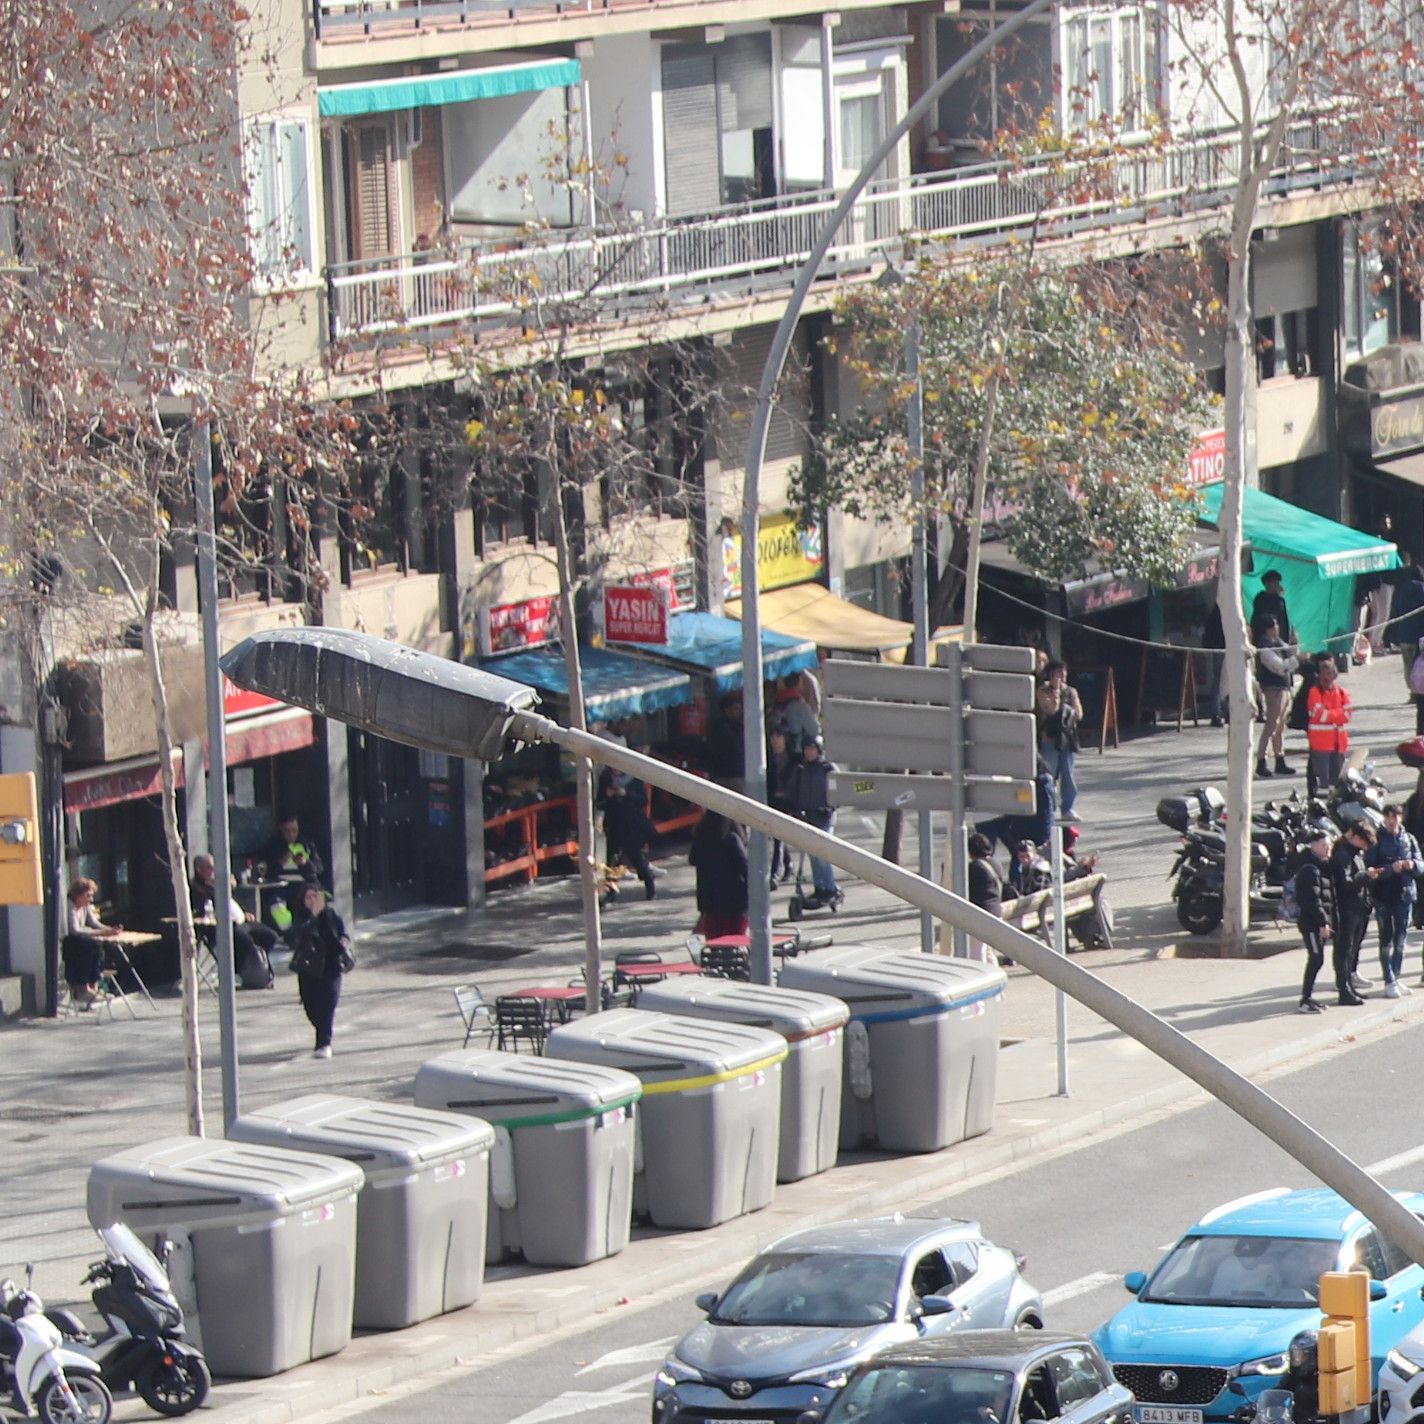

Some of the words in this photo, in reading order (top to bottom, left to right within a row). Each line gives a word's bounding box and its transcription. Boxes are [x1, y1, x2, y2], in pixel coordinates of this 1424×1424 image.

[1185, 452, 1224, 481] ATINO
[608, 598, 660, 622] YASIN
[1142, 1409, 1174, 1421] 8413
